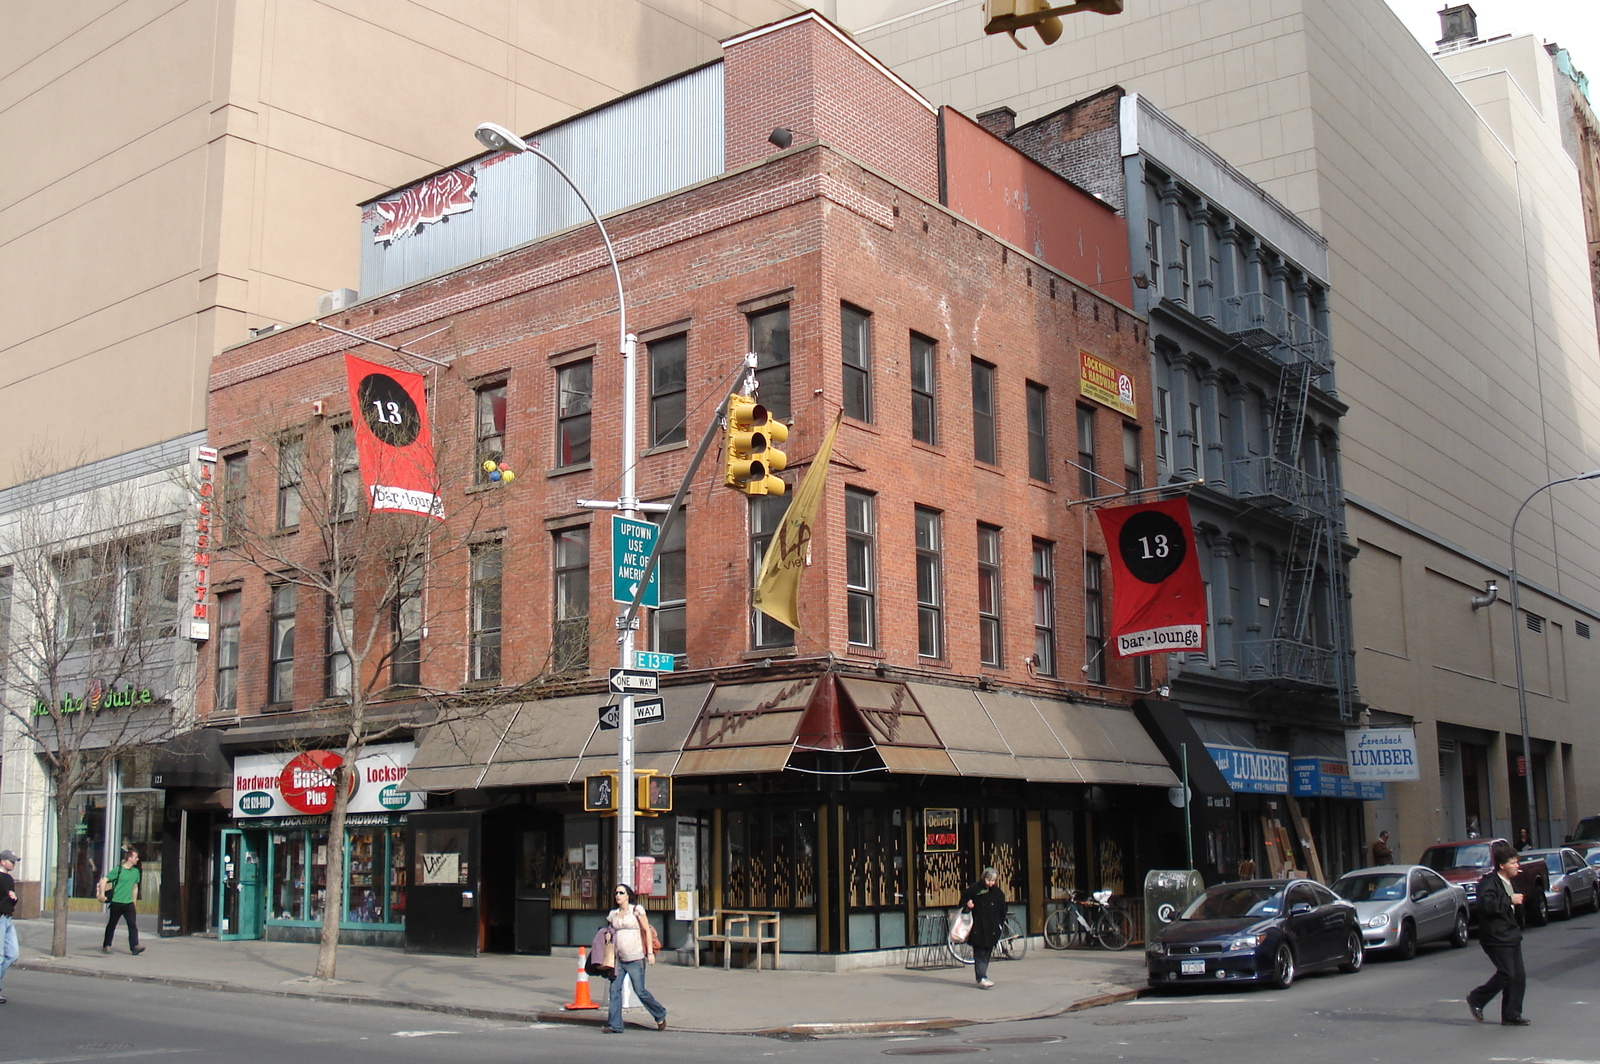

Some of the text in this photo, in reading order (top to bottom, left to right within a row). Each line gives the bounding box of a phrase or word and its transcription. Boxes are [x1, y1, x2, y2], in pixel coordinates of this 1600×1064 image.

[1084, 355, 1115, 380] LOCKSMITH
[1082, 366, 1088, 379] &
[1088, 369, 1118, 394] HARDWARE
[1119, 377, 1131, 394] 24
[373, 400, 402, 425] 13
[620, 522, 652, 541] UPTOWN
[193, 465, 213, 619] LOCKSMITH
[628, 538, 644, 553] USE
[1138, 534, 1170, 559] 13
[623, 552, 650, 568] AVE OF
[618, 565, 654, 584] AMERICS
[1121, 630, 1198, 650] bar lounge
[638, 653, 670, 669] E 13 ST
[616, 676, 653, 687] ONE WAY
[607, 705, 656, 723] ON WAY
[1358, 733, 1403, 748] Levenback
[1350, 748, 1414, 766] LUMBER
[1232, 752, 1288, 783] LUMBER
[1321, 762, 1344, 775] LUMBER
[236, 775, 280, 792] Hardware
[1227, 781, 1244, 790] -2994
[306, 790, 328, 806] Plus
[382, 797, 407, 806] SECURITY
[280, 815, 329, 827] LOCKSMITH
[345, 815, 389, 826] ARDWARE
[928, 814, 953, 830] Delivery
